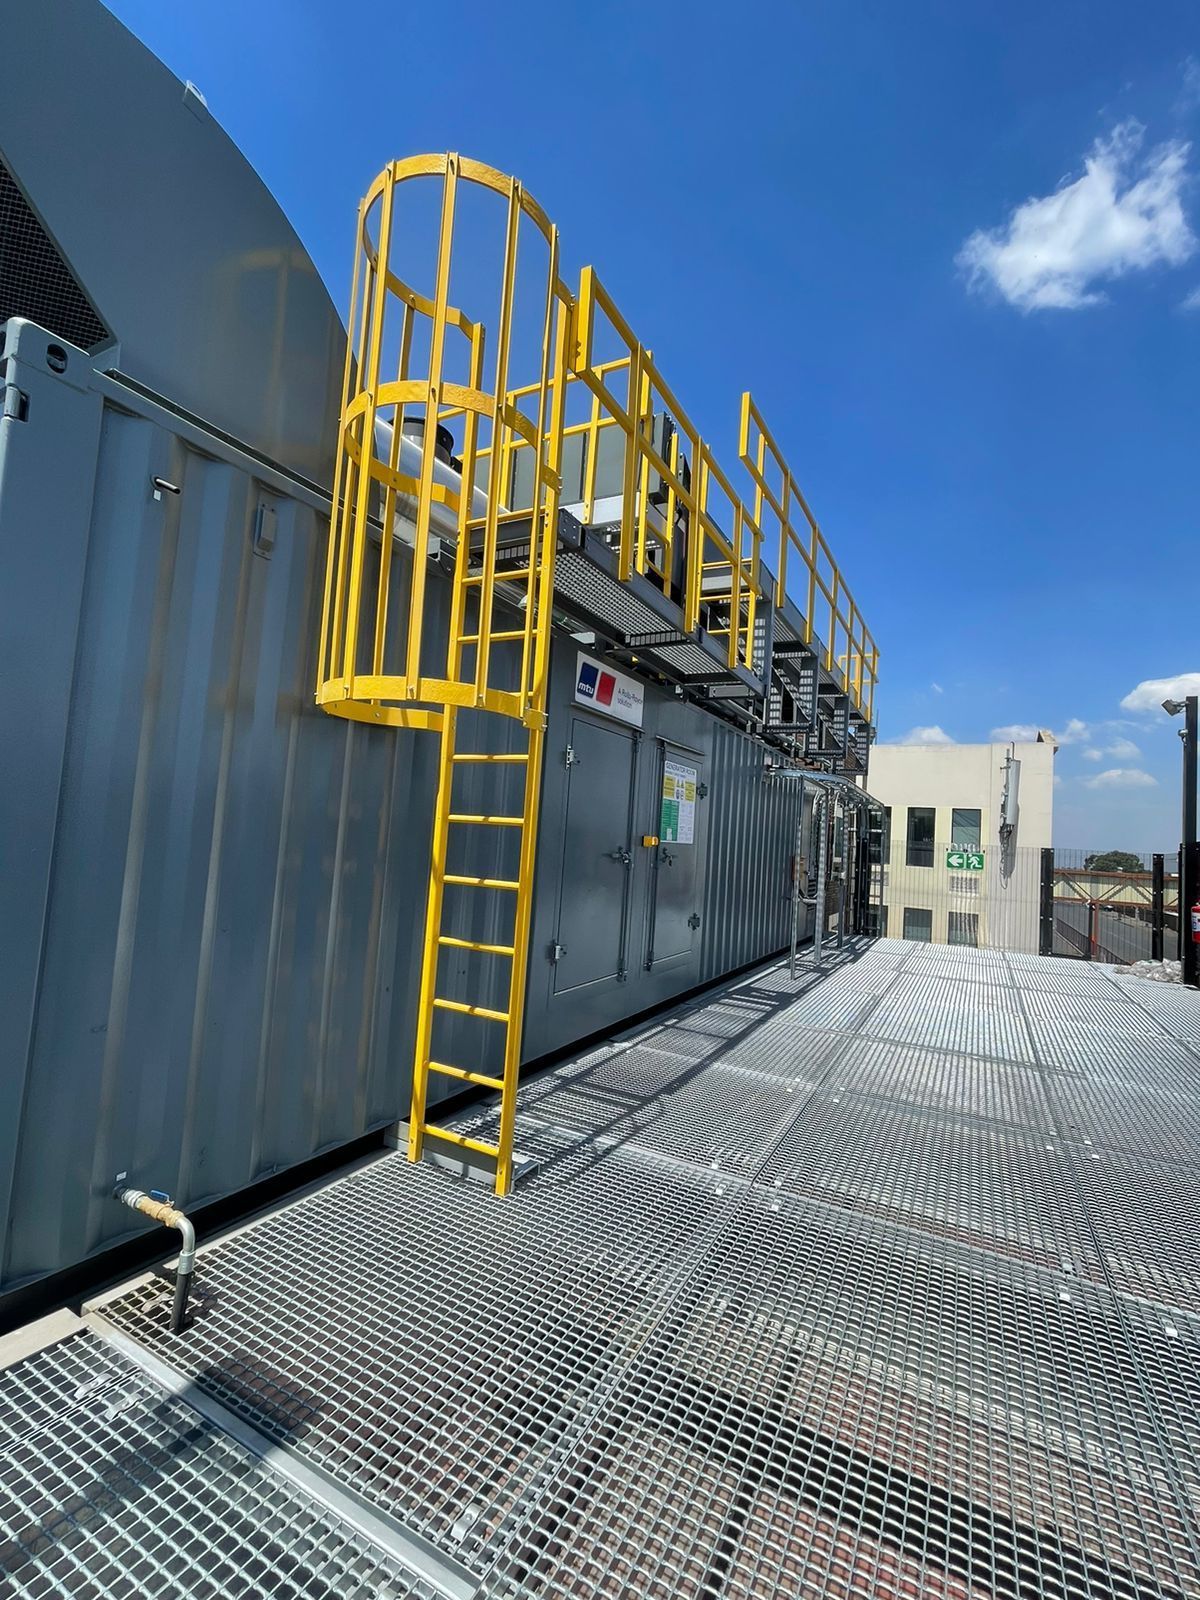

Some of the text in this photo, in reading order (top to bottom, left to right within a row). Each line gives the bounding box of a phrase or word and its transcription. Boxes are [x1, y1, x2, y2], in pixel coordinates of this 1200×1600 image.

[578, 682, 594, 695] mtu
[666, 762, 685, 773] GENERATOR
[686, 767, 695, 776] ROOM
